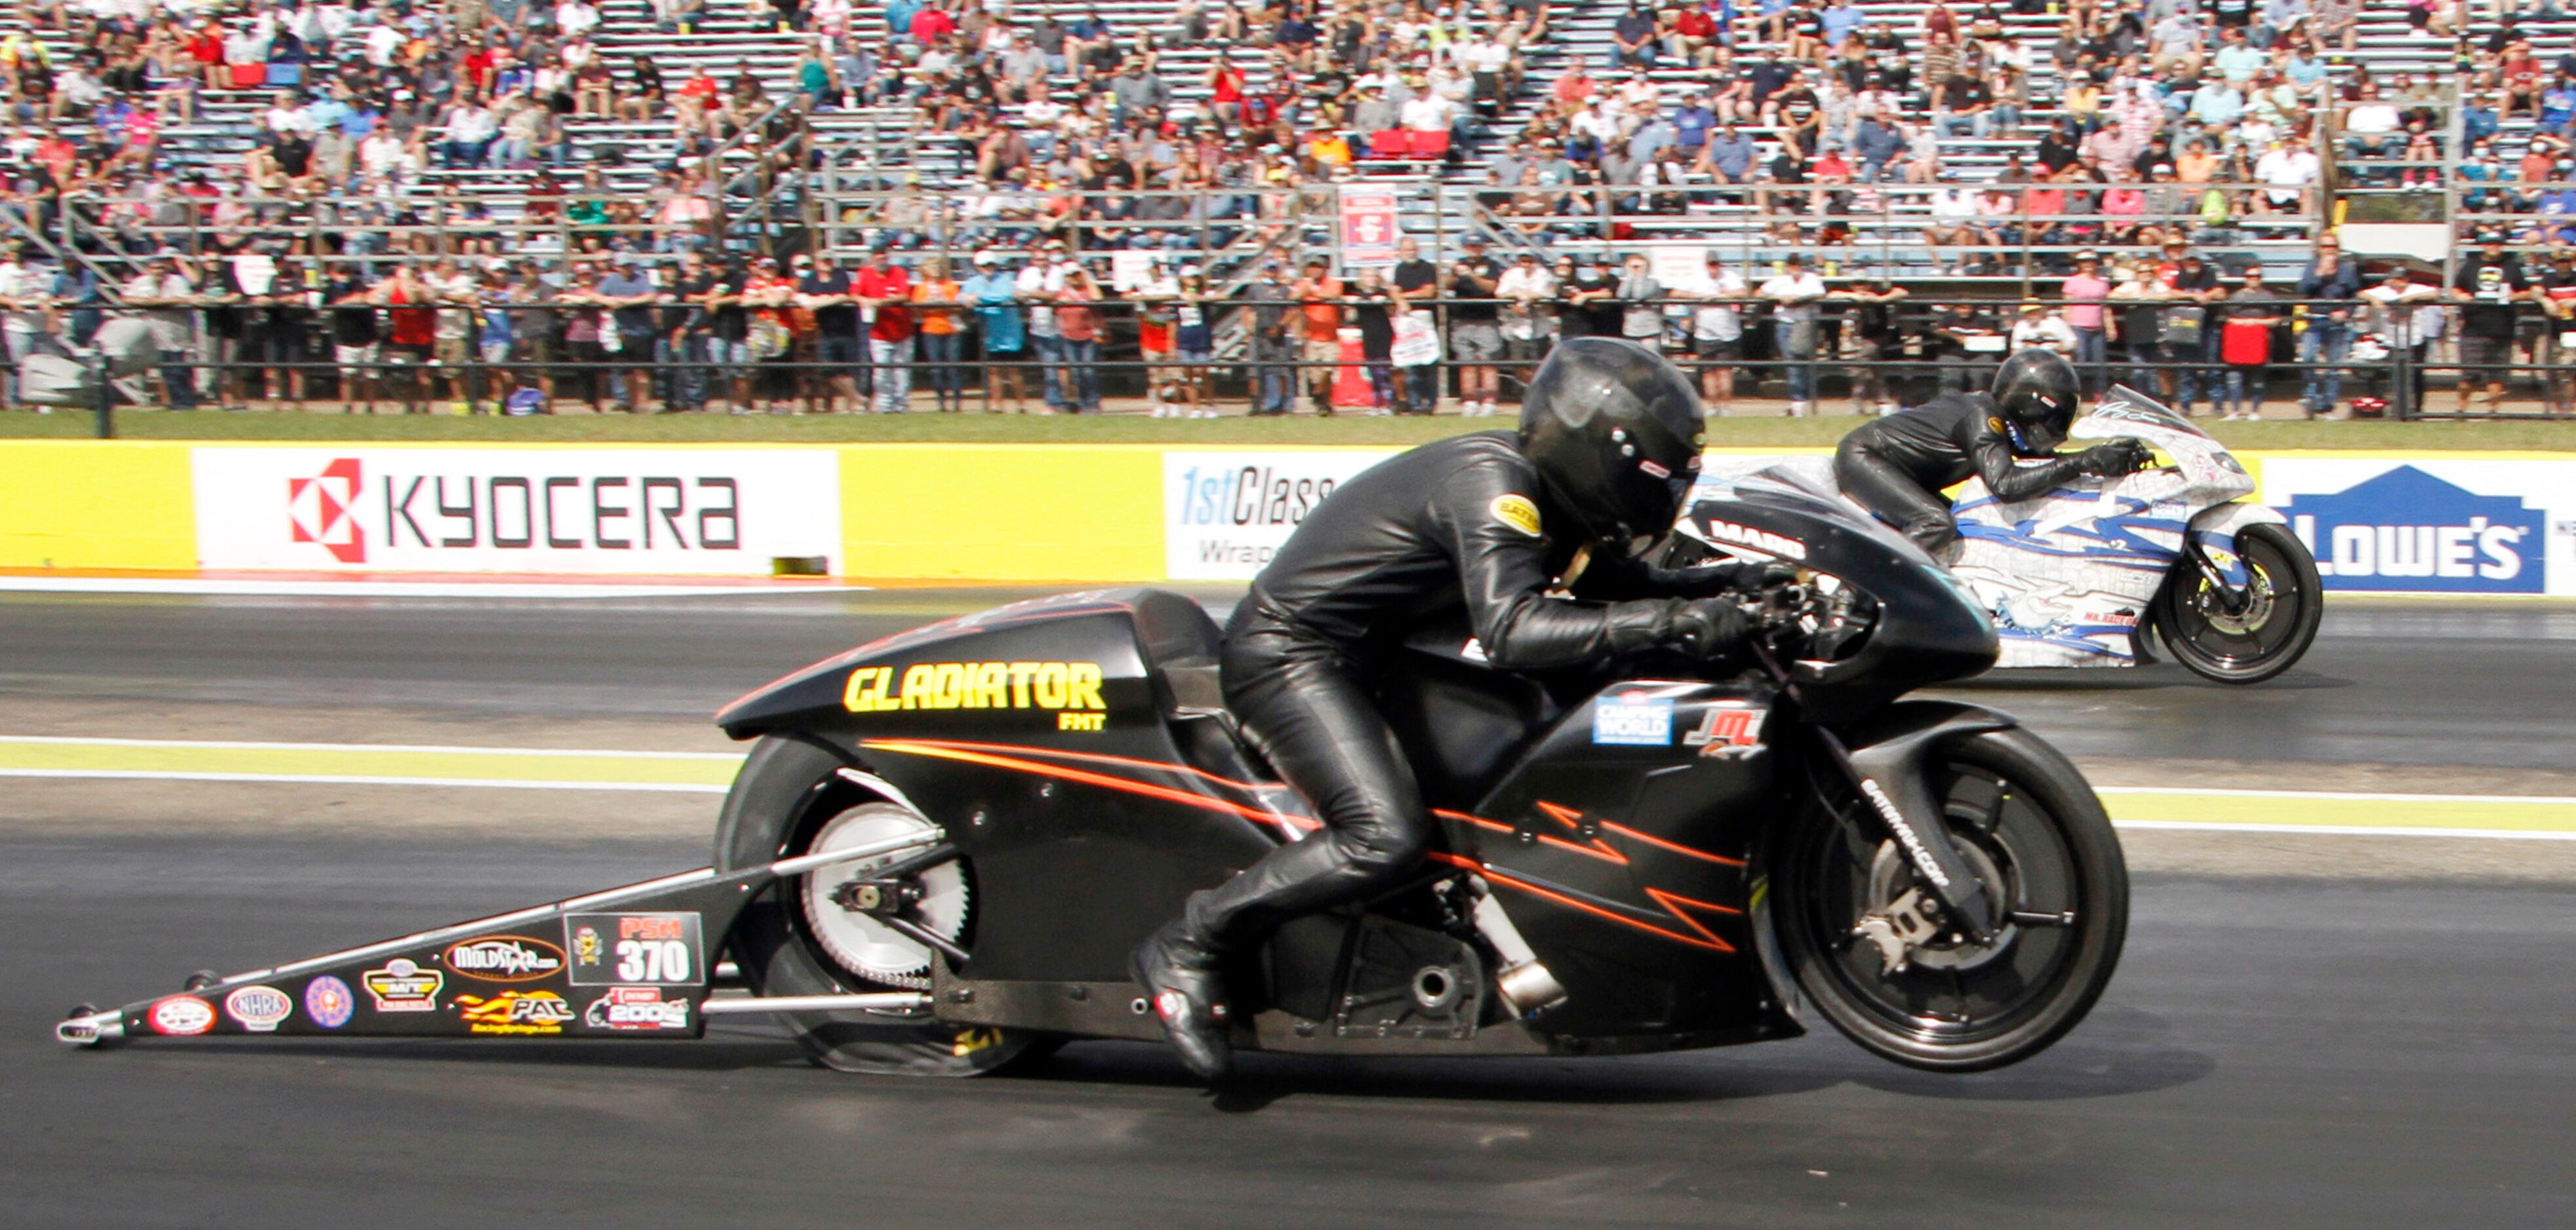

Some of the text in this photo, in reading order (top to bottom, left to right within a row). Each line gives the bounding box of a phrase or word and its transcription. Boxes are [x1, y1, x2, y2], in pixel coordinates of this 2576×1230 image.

[385, 475, 740, 549] KYOCERA
[1199, 539, 1276, 569] Wrap
[2294, 514, 2522, 580] LOWE'S
[843, 662, 1107, 713] GLADIATOR
[1058, 712, 1107, 730] FMT
[1598, 718, 1668, 736] WORLD
[619, 917, 682, 939] PSM
[616, 939, 690, 982] 370
[238, 994, 282, 1016] NHRA
